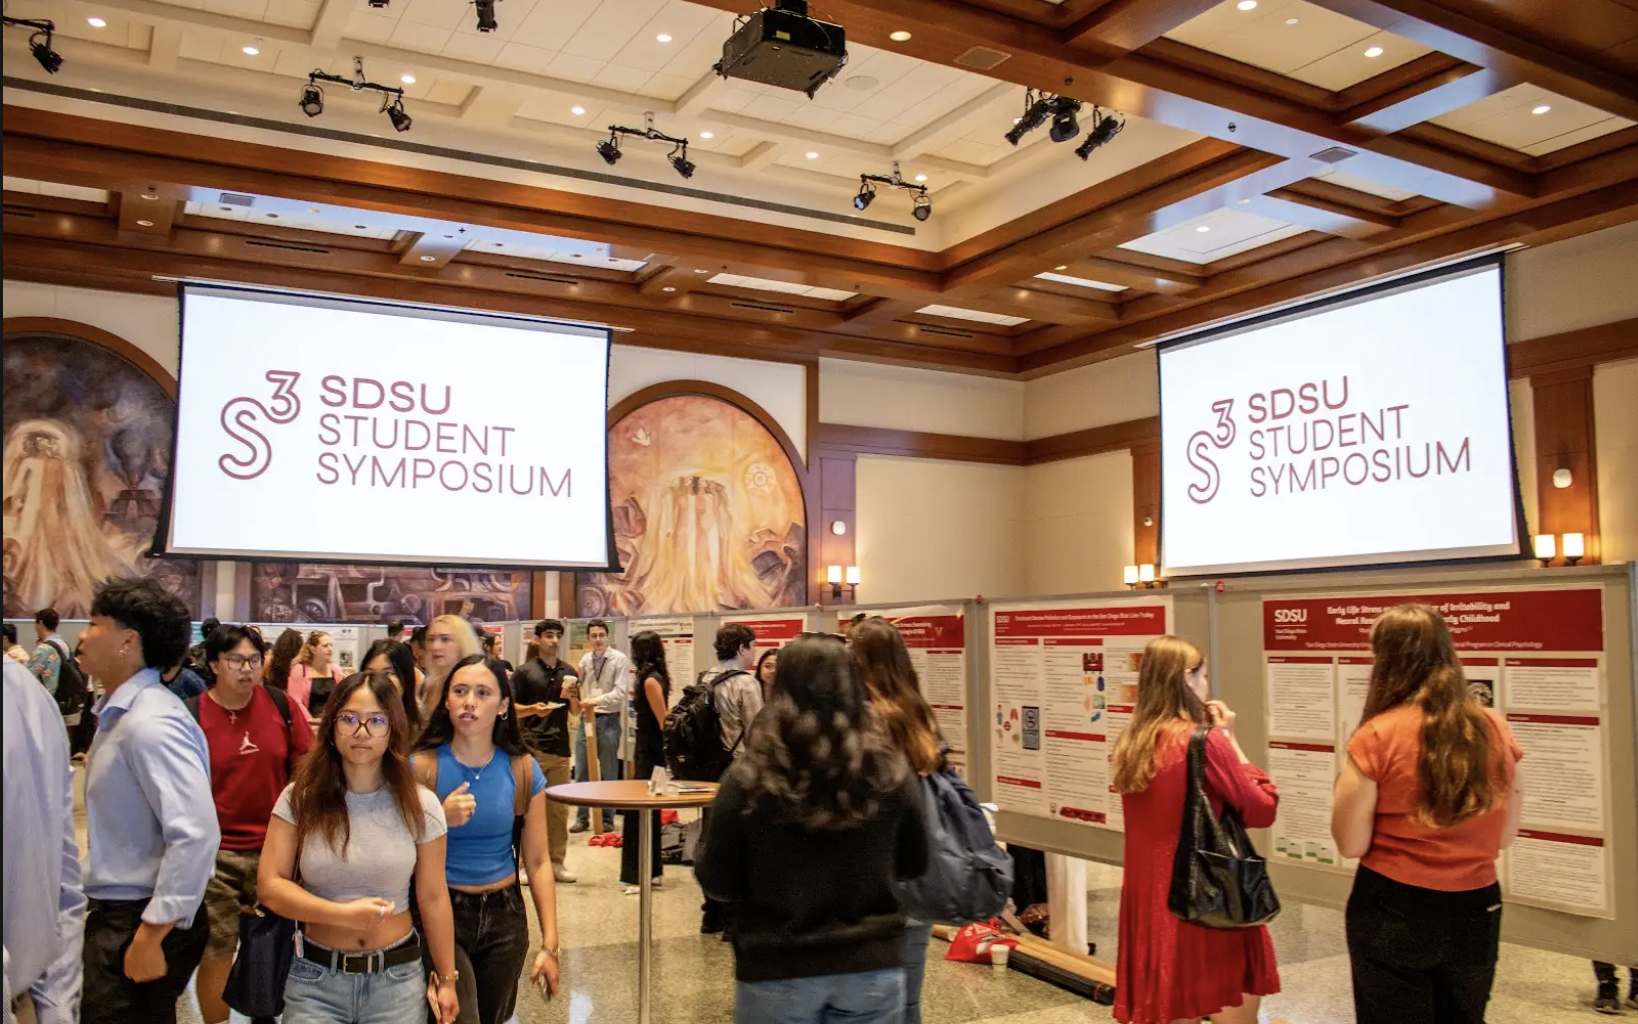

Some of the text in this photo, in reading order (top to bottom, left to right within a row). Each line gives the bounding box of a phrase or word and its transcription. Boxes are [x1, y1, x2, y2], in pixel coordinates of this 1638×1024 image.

[319, 375, 452, 415] SDSU
[1248, 375, 1348, 423] SDSU
[317, 413, 516, 457] STUDENT
[1250, 404, 1409, 461] STUDENT
[316, 452, 572, 498] SYMPOSIUM
[1250, 436, 1471, 498] SYMPOSIUM
[1274, 608, 1307, 622] SDSU
[1327, 606, 1346, 616] Early
[1346, 605, 1360, 615] Life
[1360, 605, 1383, 614] Stress
[1440, 603, 1449, 613] of
[1449, 602, 1493, 612] Irritability
[1493, 601, 1510, 610] and
[1459, 614, 1500, 622] Childhood
